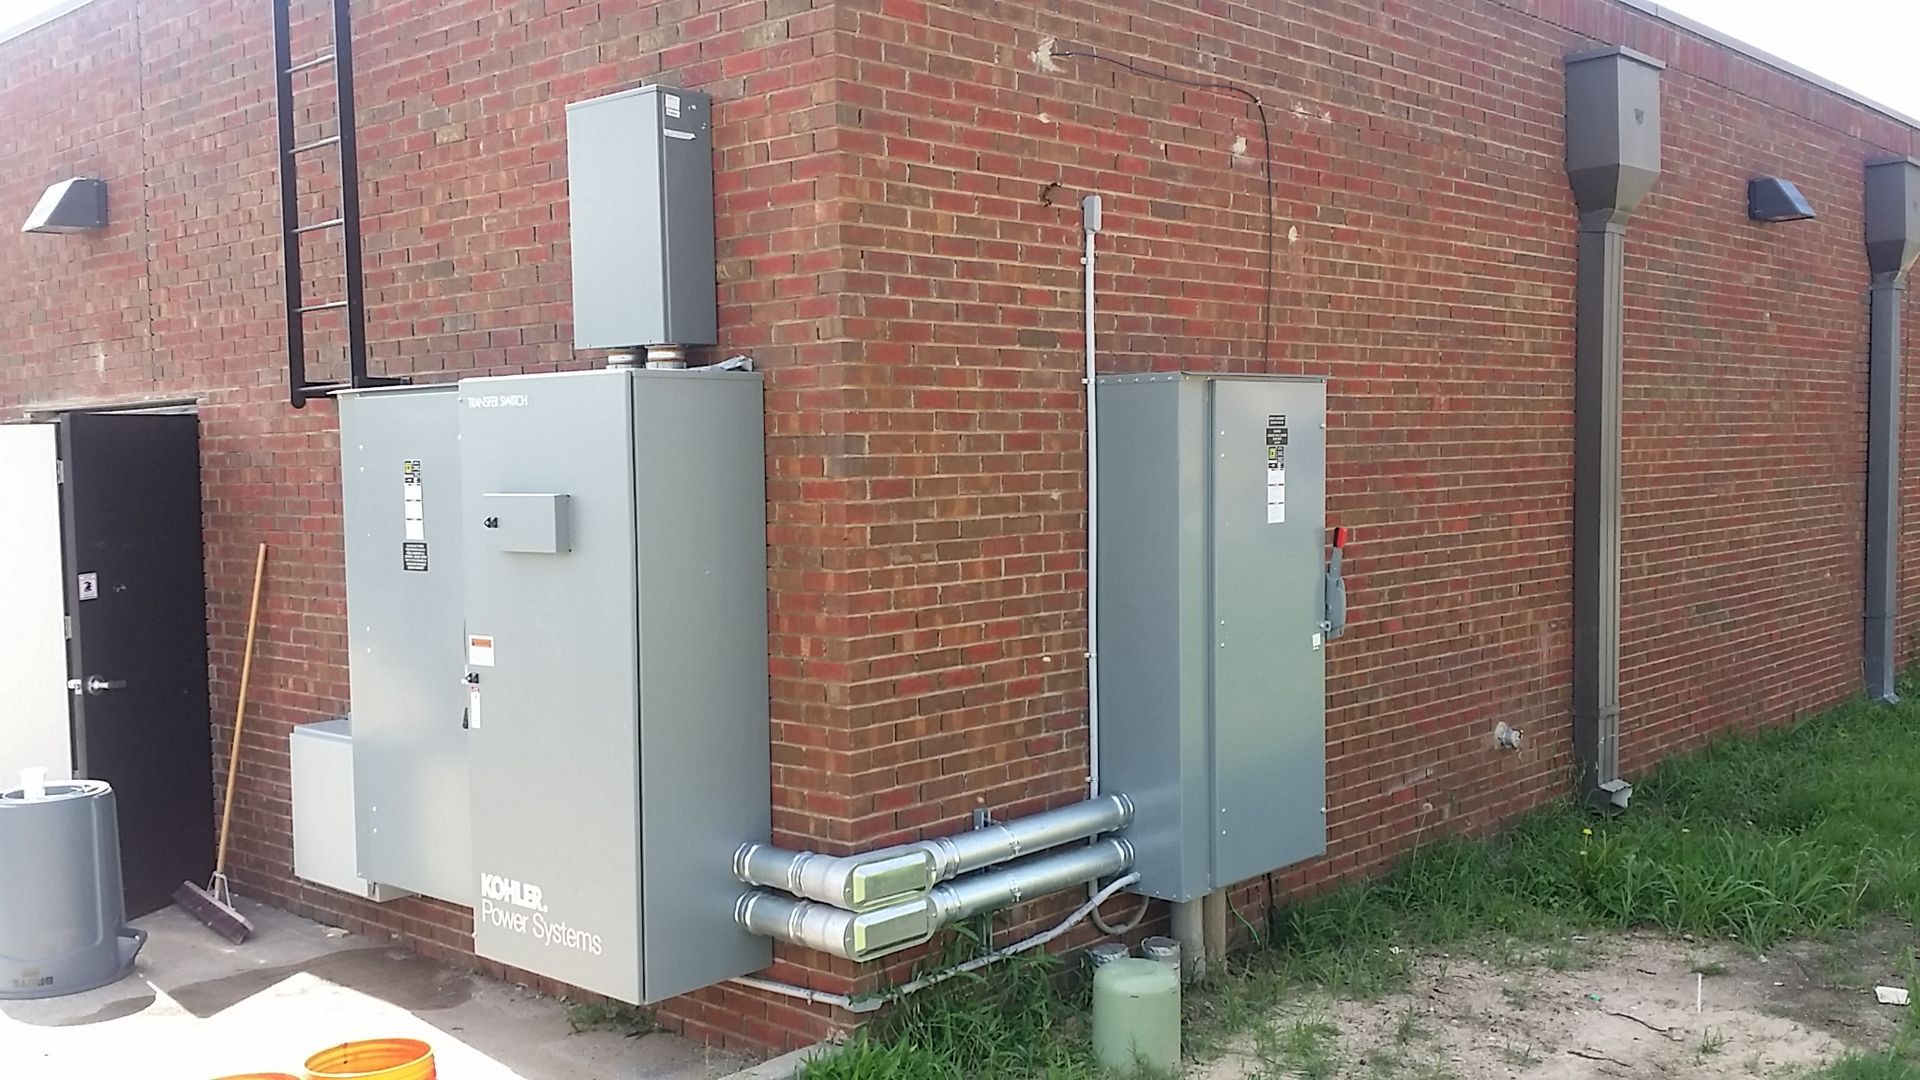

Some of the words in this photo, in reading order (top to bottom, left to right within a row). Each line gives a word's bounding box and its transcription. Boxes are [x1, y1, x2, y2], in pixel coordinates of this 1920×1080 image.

[467, 396, 499, 408] TRANSFER
[500, 395, 528, 407] SWITCH
[482, 898, 528, 934] Power
[532, 912, 602, 956] Systems
